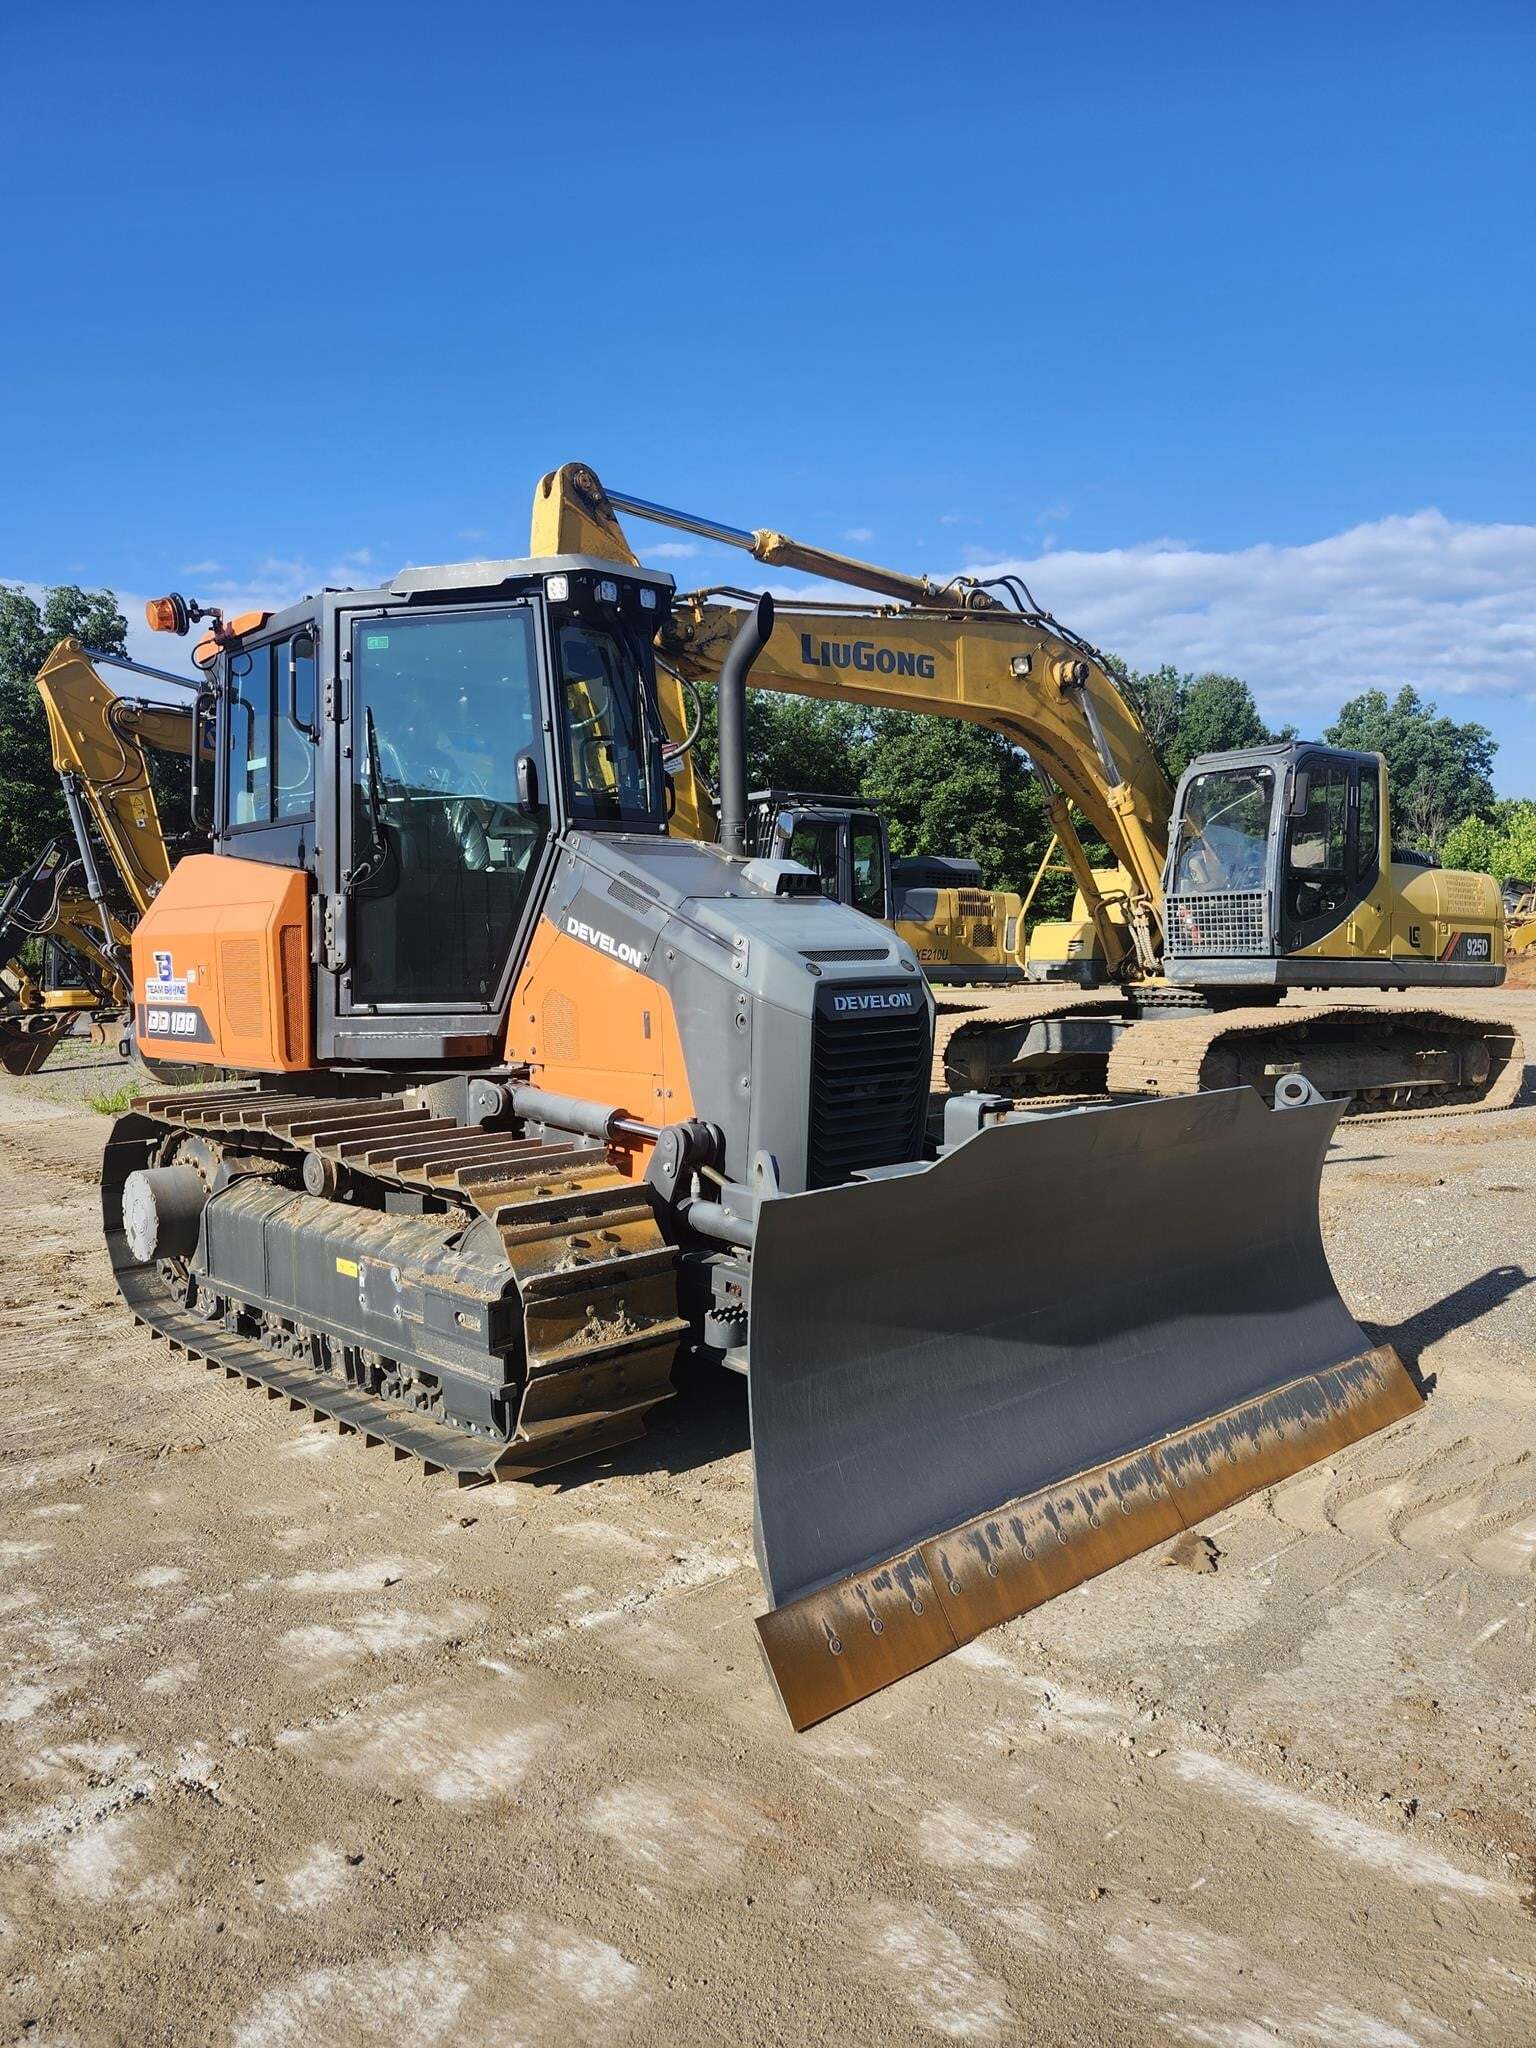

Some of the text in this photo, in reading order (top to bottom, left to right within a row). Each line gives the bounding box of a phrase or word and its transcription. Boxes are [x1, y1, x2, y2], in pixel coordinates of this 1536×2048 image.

[801, 633, 935, 679] LIUGONG
[566, 916, 642, 968] DEVELON
[1466, 938, 1489, 956] 925D
[833, 993, 913, 1011] DEVELON
